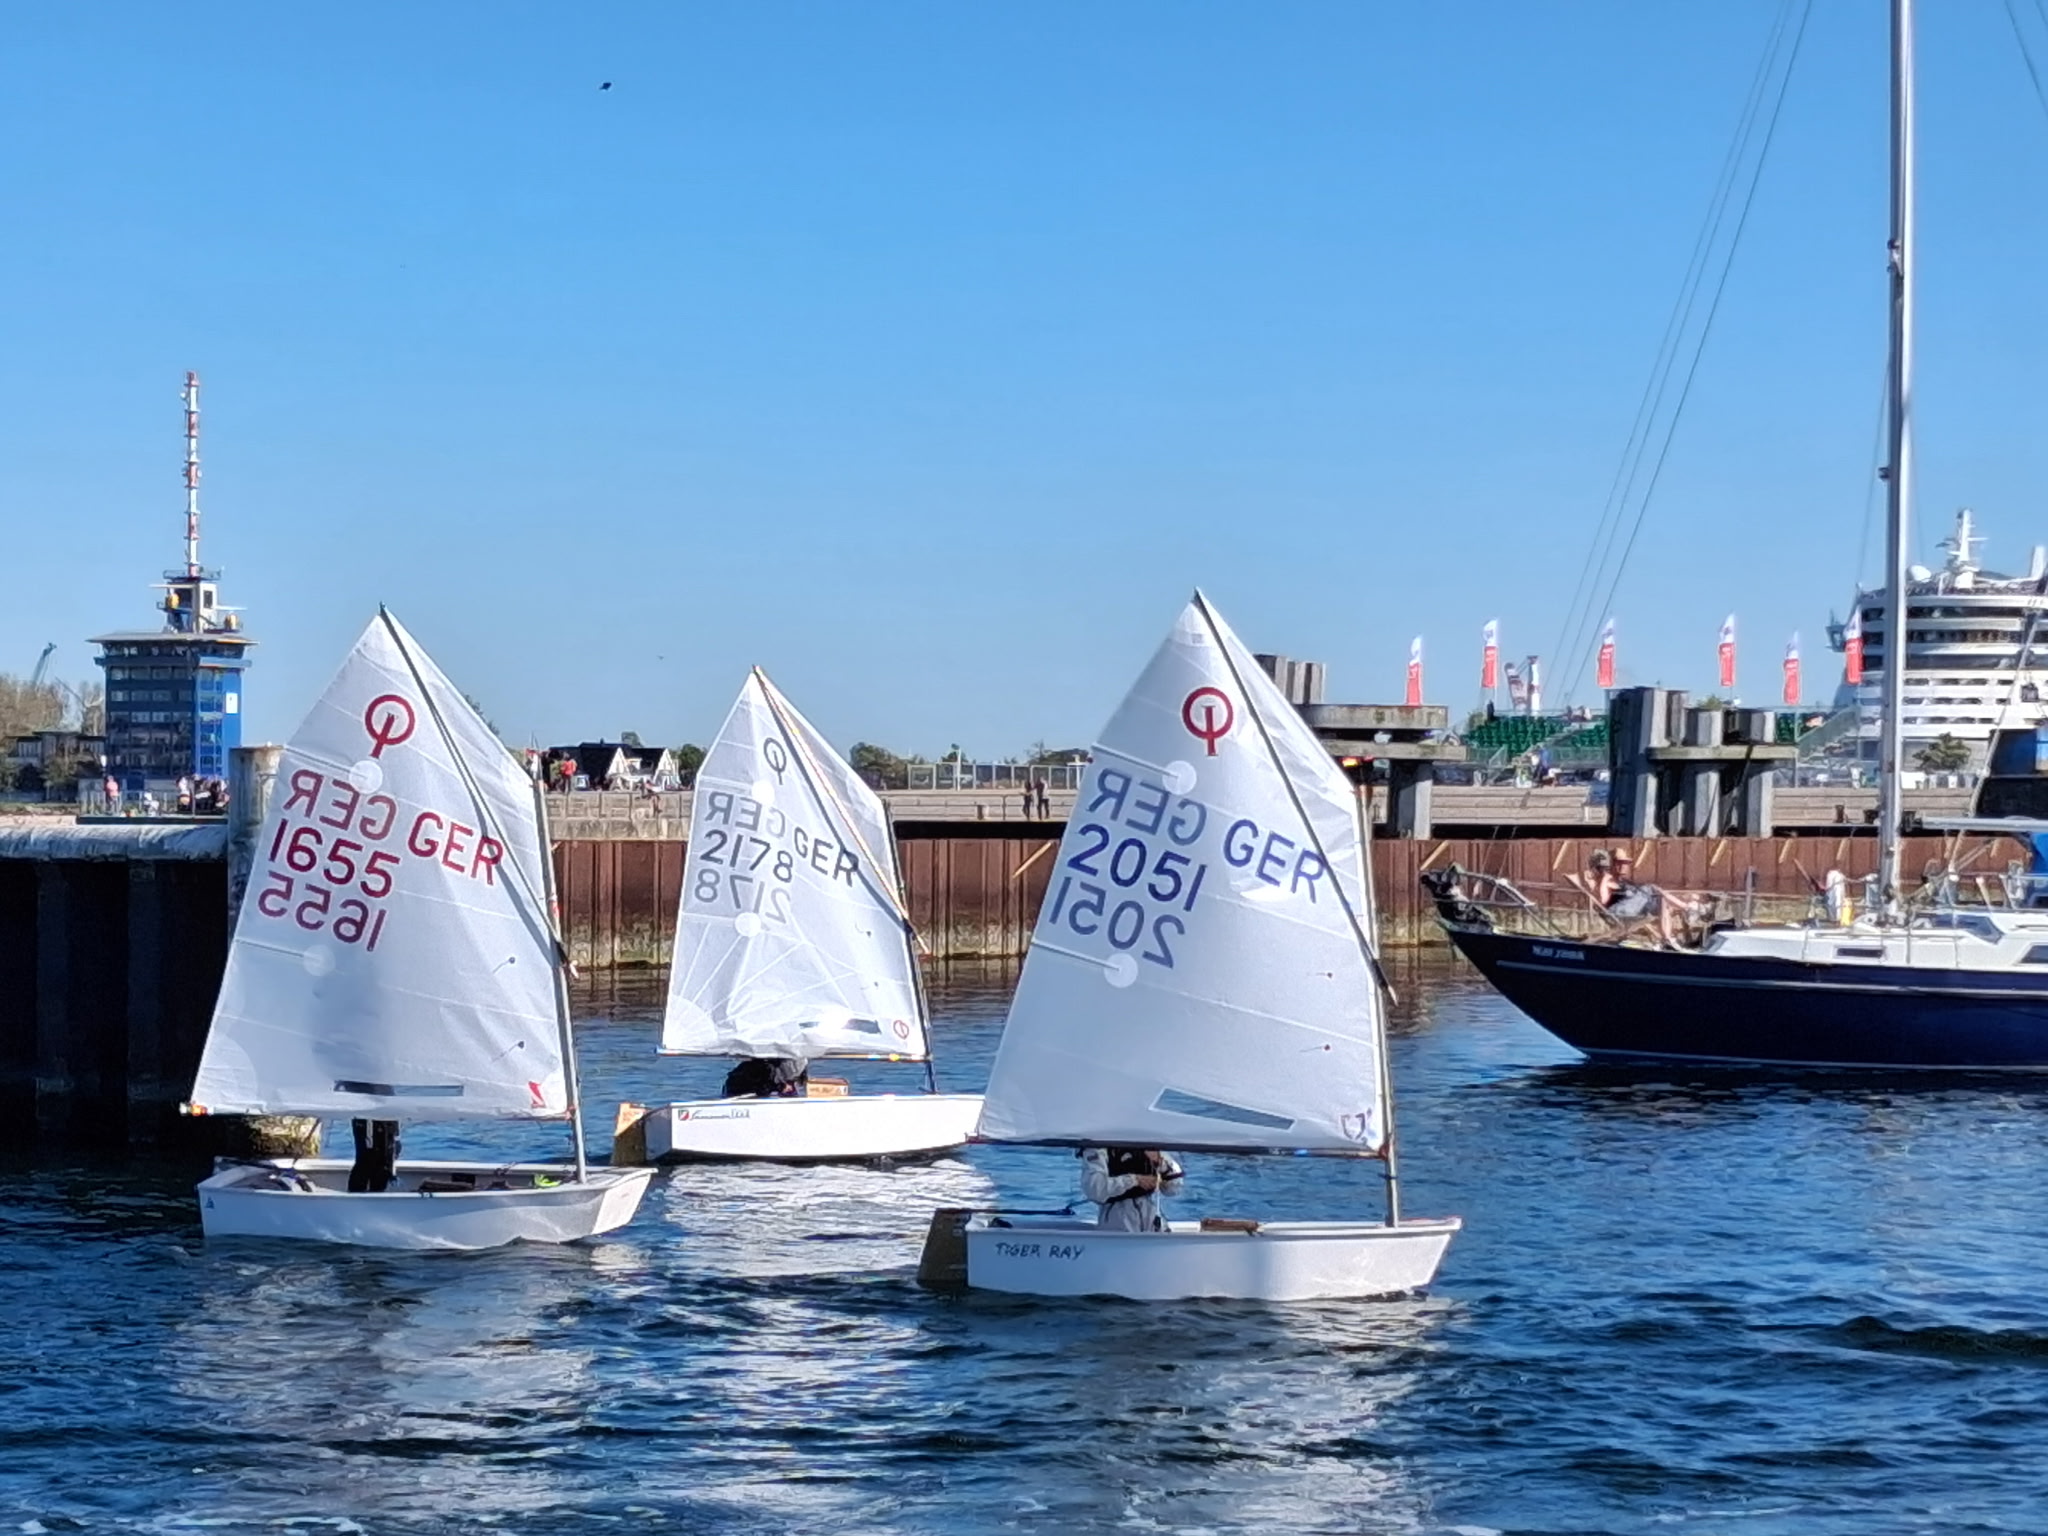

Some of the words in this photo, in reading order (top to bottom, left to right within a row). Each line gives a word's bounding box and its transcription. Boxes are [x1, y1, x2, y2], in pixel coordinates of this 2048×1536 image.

[268, 818, 401, 899] 1655
[407, 811, 503, 886] GER
[699, 829, 794, 883] 2178
[793, 826, 860, 888] GER
[1067, 823, 1207, 912] 2051
[1222, 819, 1328, 904] GER
[995, 1242, 1040, 1258] TIGER
[1048, 1244, 1085, 1261] RAY
